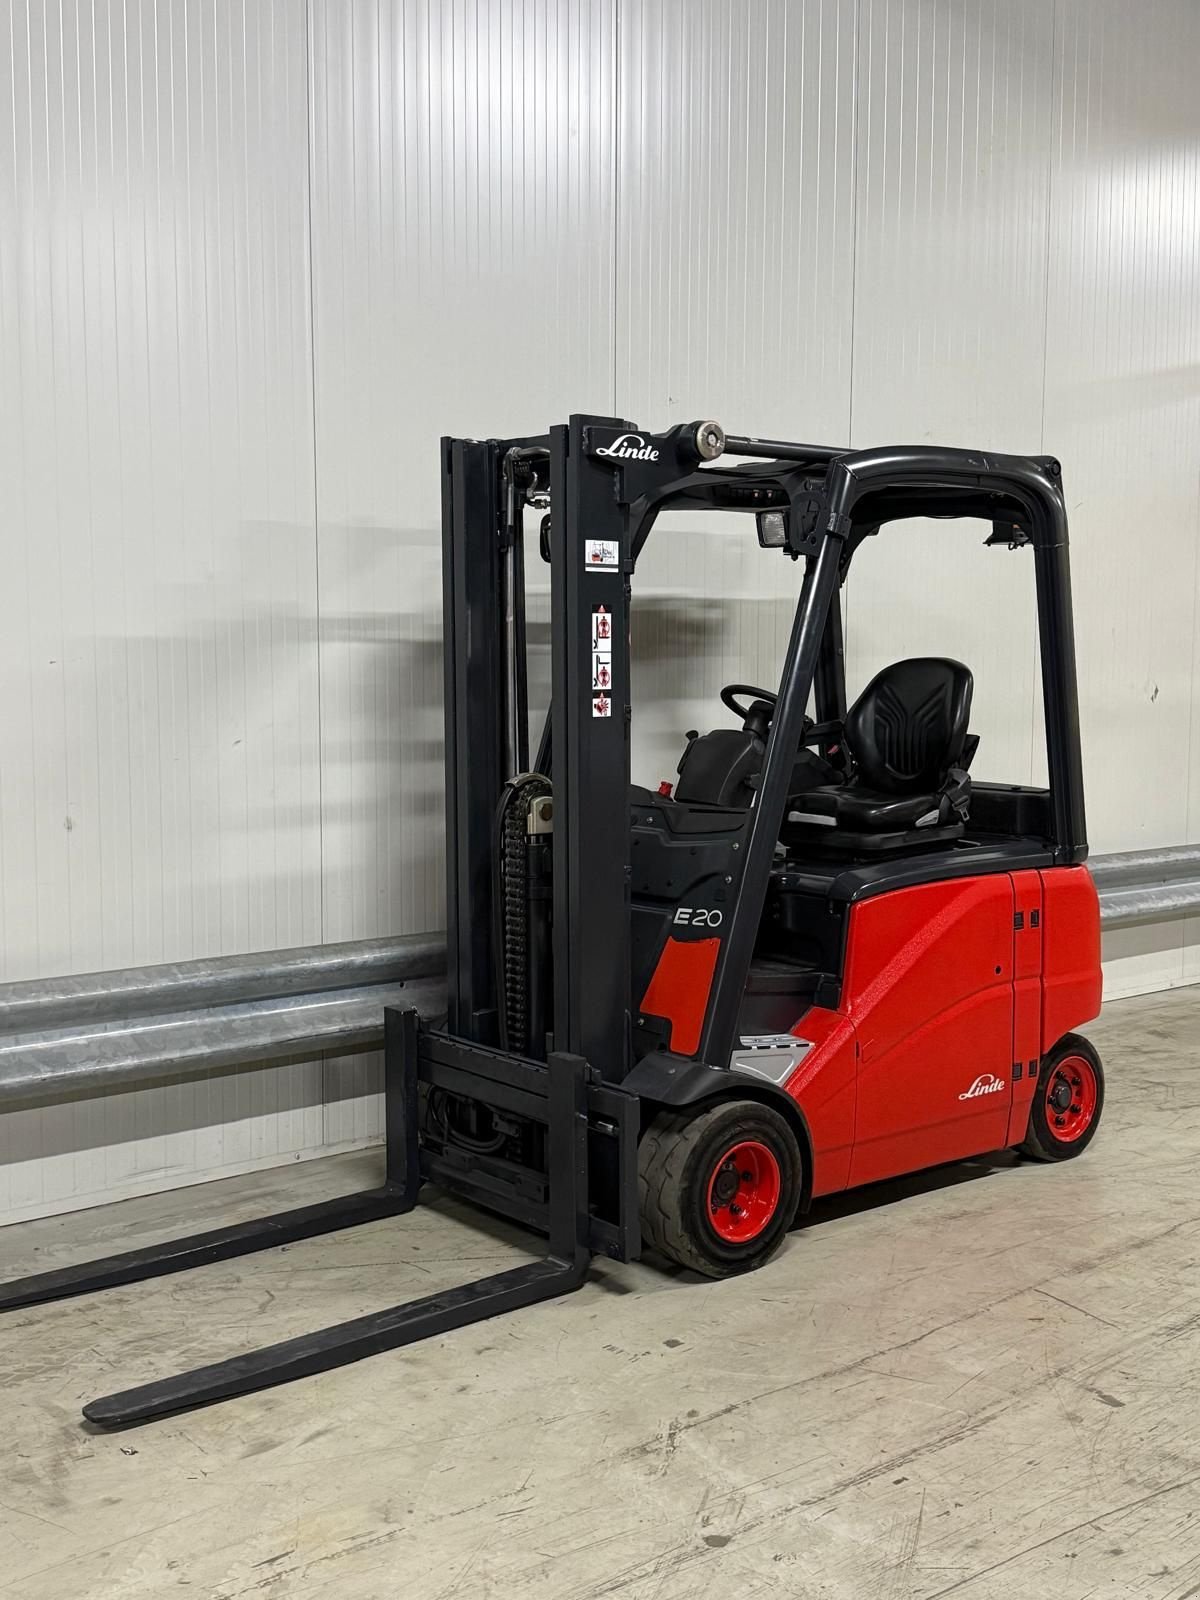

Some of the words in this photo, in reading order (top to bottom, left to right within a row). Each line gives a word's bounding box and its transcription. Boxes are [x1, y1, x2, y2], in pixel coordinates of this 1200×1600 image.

[596, 434, 660, 462] Linde
[673, 907, 723, 928] E20
[958, 1073, 1005, 1101] Linde
